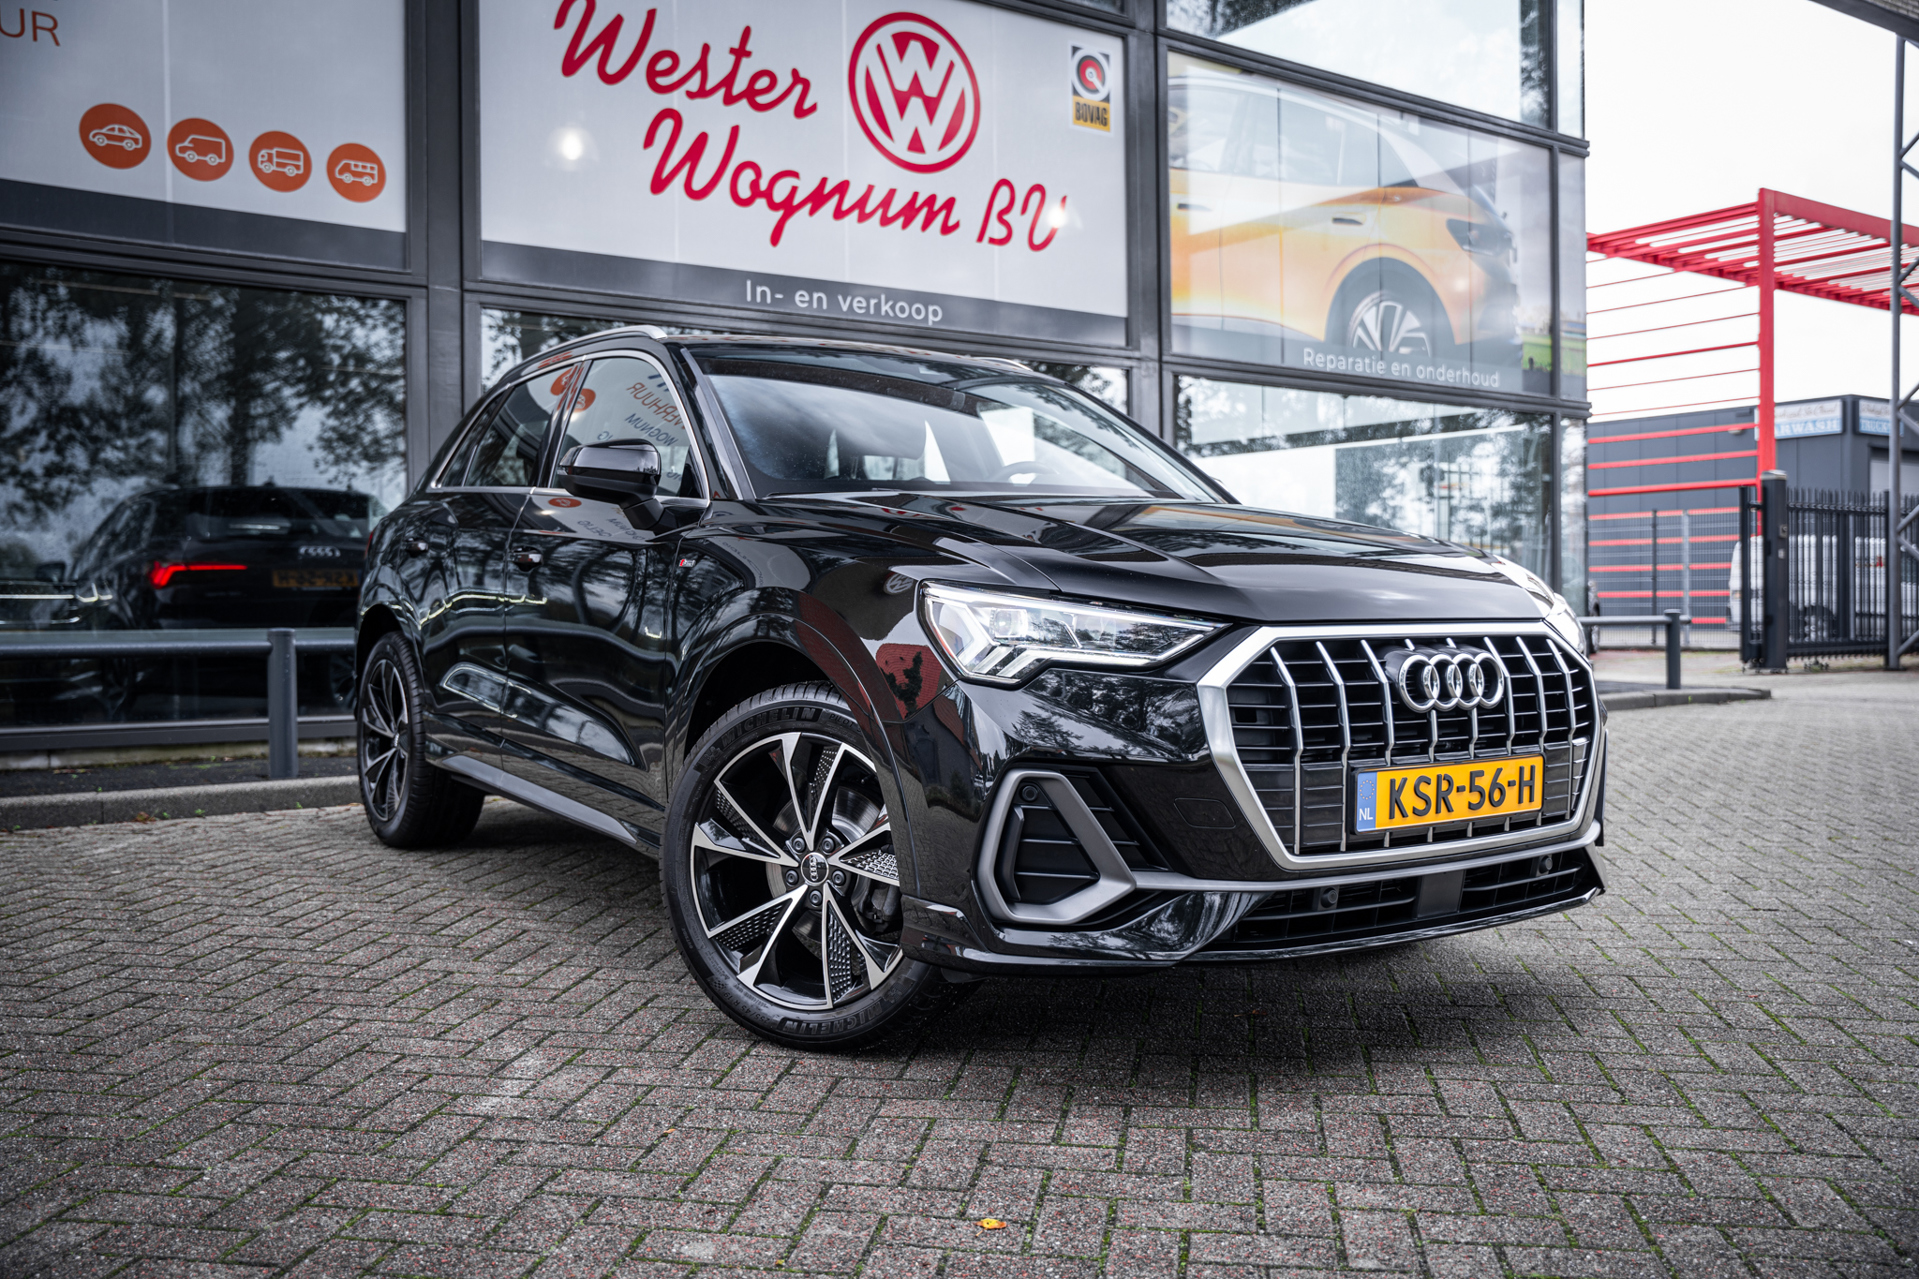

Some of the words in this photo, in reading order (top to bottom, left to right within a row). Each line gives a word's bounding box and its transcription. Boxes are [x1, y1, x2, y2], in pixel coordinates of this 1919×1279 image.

[554, 0, 817, 119] Wester
[1075, 101, 1108, 127] BOVAG
[643, 108, 960, 247] Wognum
[976, 178, 1068, 252] BV
[746, 279, 784, 304] In-
[794, 289, 827, 310] en
[837, 293, 943, 326] verkoop
[1303, 348, 1386, 375] Reparatie
[1391, 361, 1411, 377] en
[1416, 363, 1499, 388] onderhoud
[721, 708, 816, 748] MICHELIN
[829, 713, 854, 728] PILOT
[1389, 765, 1536, 820] KSR-56-H
[1359, 808, 1373, 821] NL
[783, 1001, 883, 1035] MICHELIN
